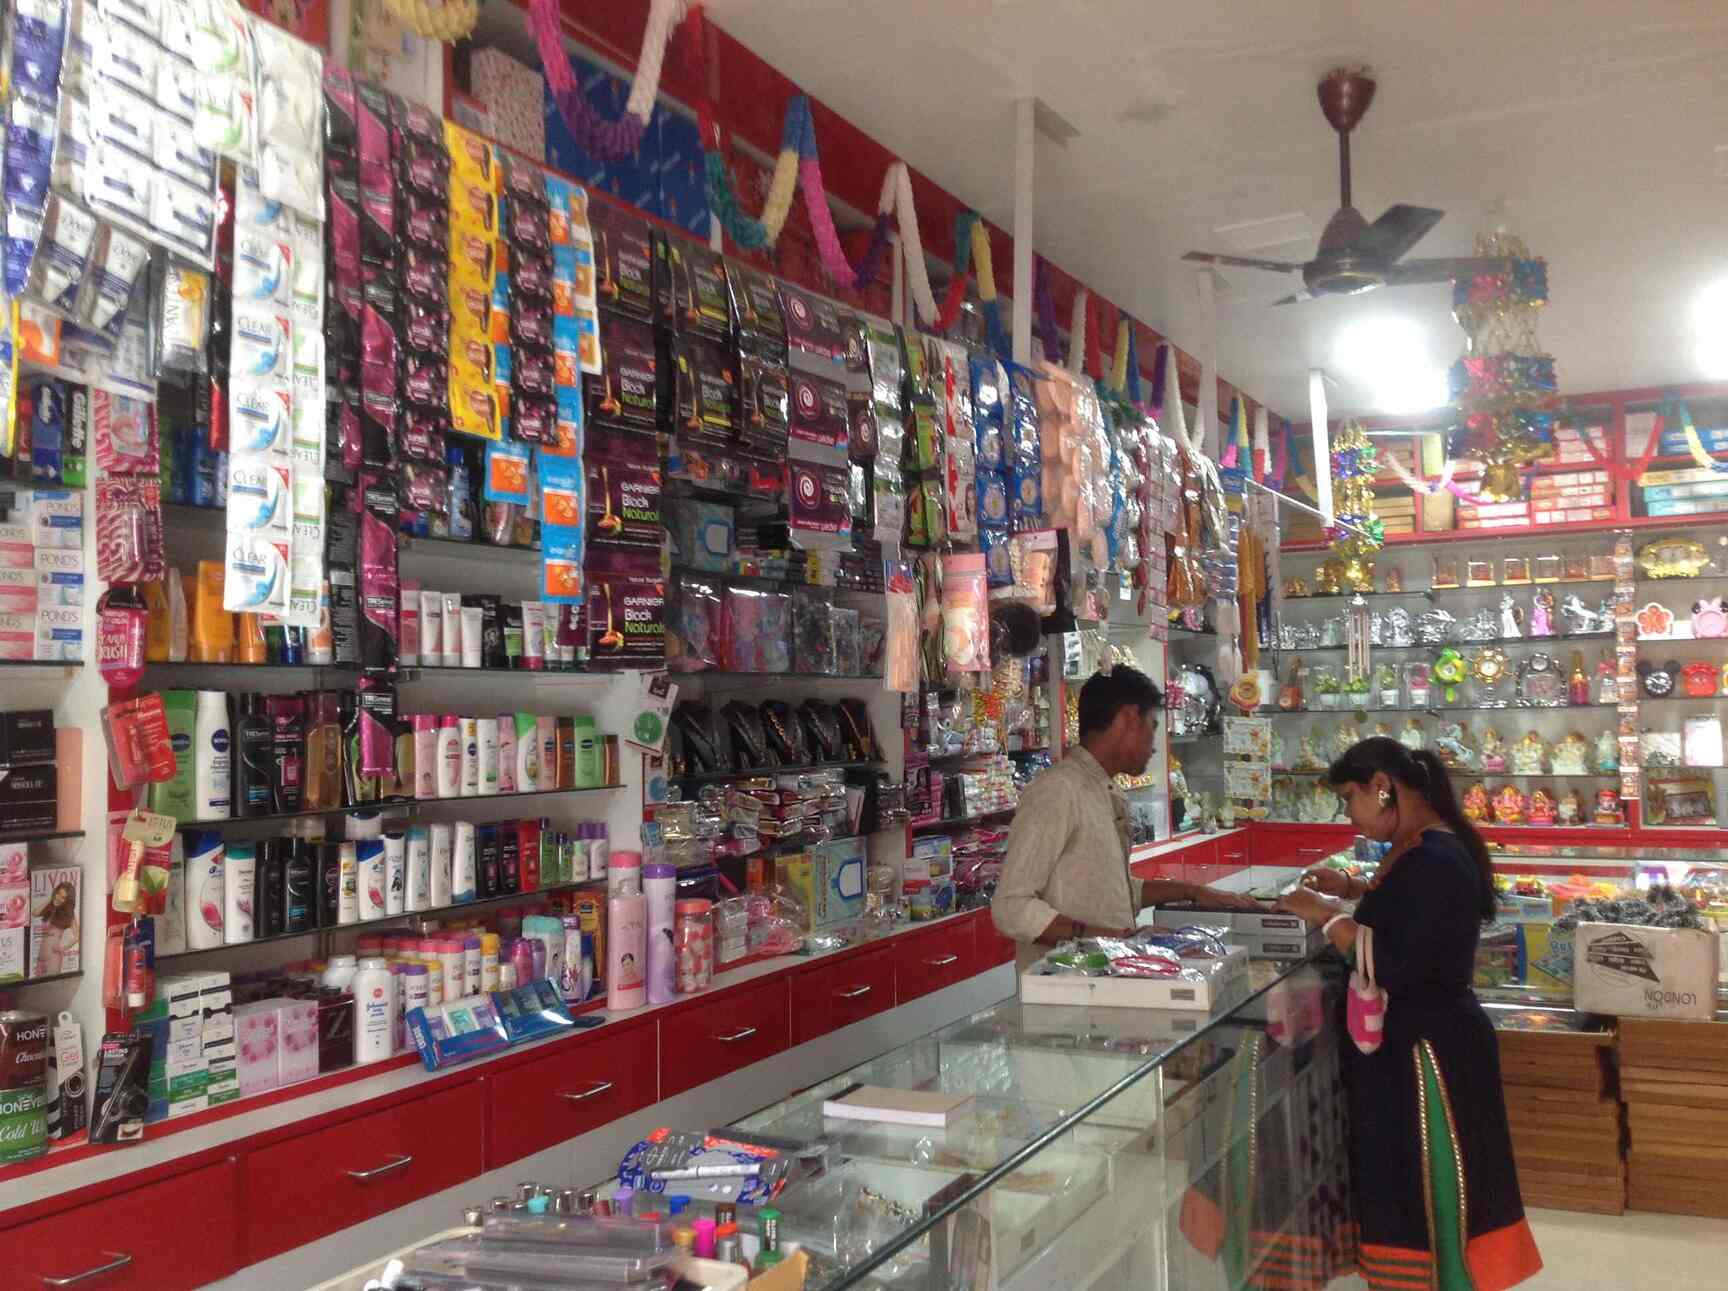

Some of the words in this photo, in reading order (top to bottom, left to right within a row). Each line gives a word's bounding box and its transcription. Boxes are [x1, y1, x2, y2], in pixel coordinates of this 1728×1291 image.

[72, 391, 86, 448] Gillette
[624, 597, 664, 607] GARNIER
[624, 608, 653, 621] Black
[33, 870, 79, 894] LIVON
[1644, 990, 1697, 1006] LONDON
[16, 1027, 47, 1041] HONE
